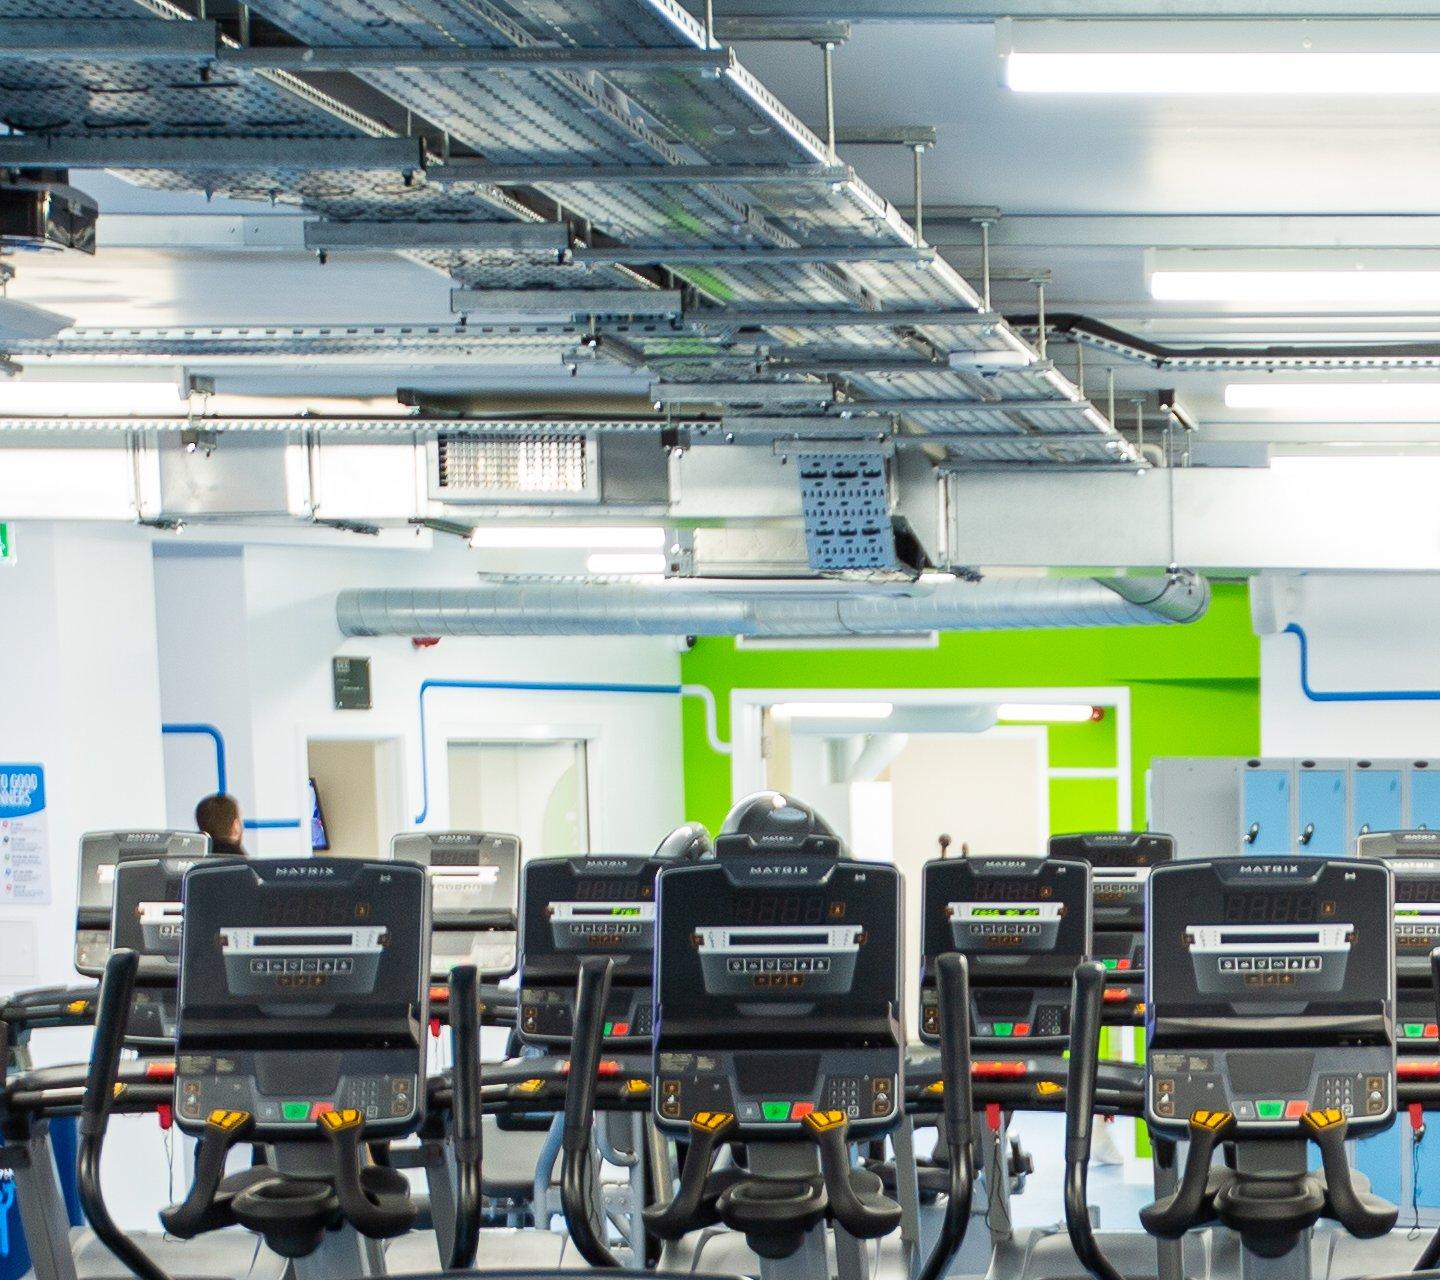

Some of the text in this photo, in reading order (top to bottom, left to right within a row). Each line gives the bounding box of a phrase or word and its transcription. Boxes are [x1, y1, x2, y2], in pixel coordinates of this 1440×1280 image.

[275, 866, 335, 877] MATRIX
[749, 866, 809, 876] MATRIX
[1240, 864, 1299, 873] MATRIX
